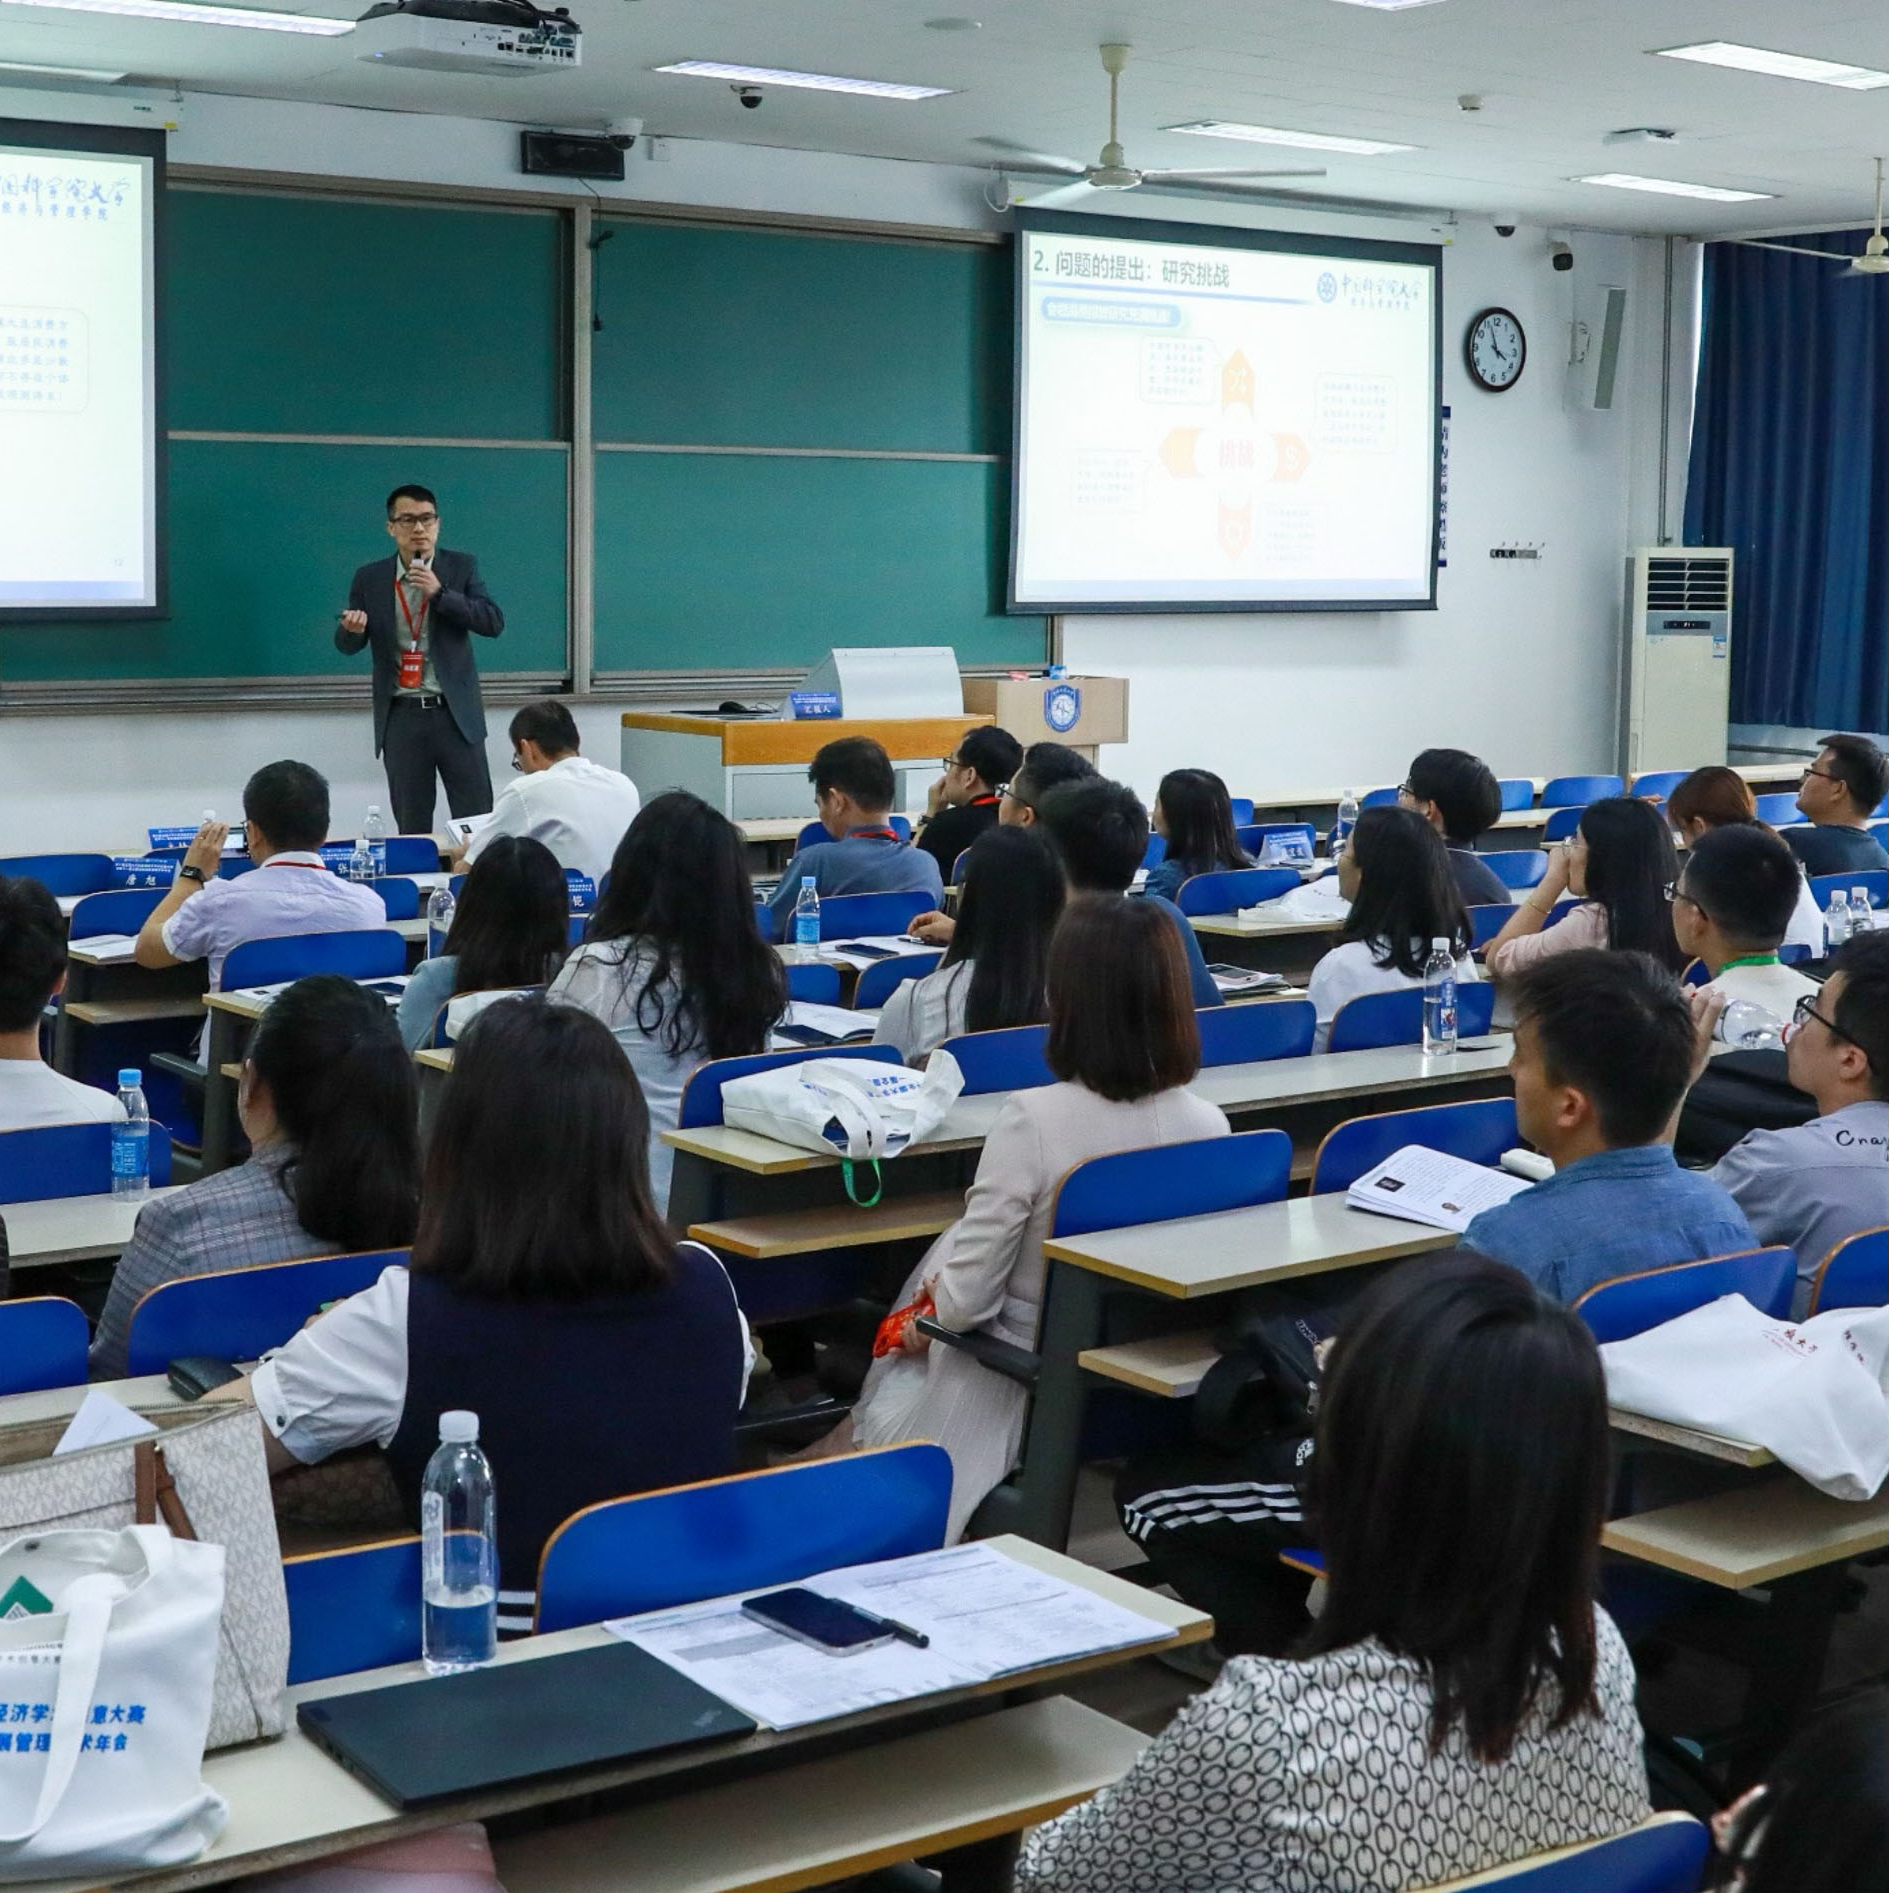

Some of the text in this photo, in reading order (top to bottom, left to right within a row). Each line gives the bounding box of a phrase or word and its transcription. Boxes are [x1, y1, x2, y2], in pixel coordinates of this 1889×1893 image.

[1033, 250, 1231, 288] 2. 问题的提出：研究挑战
